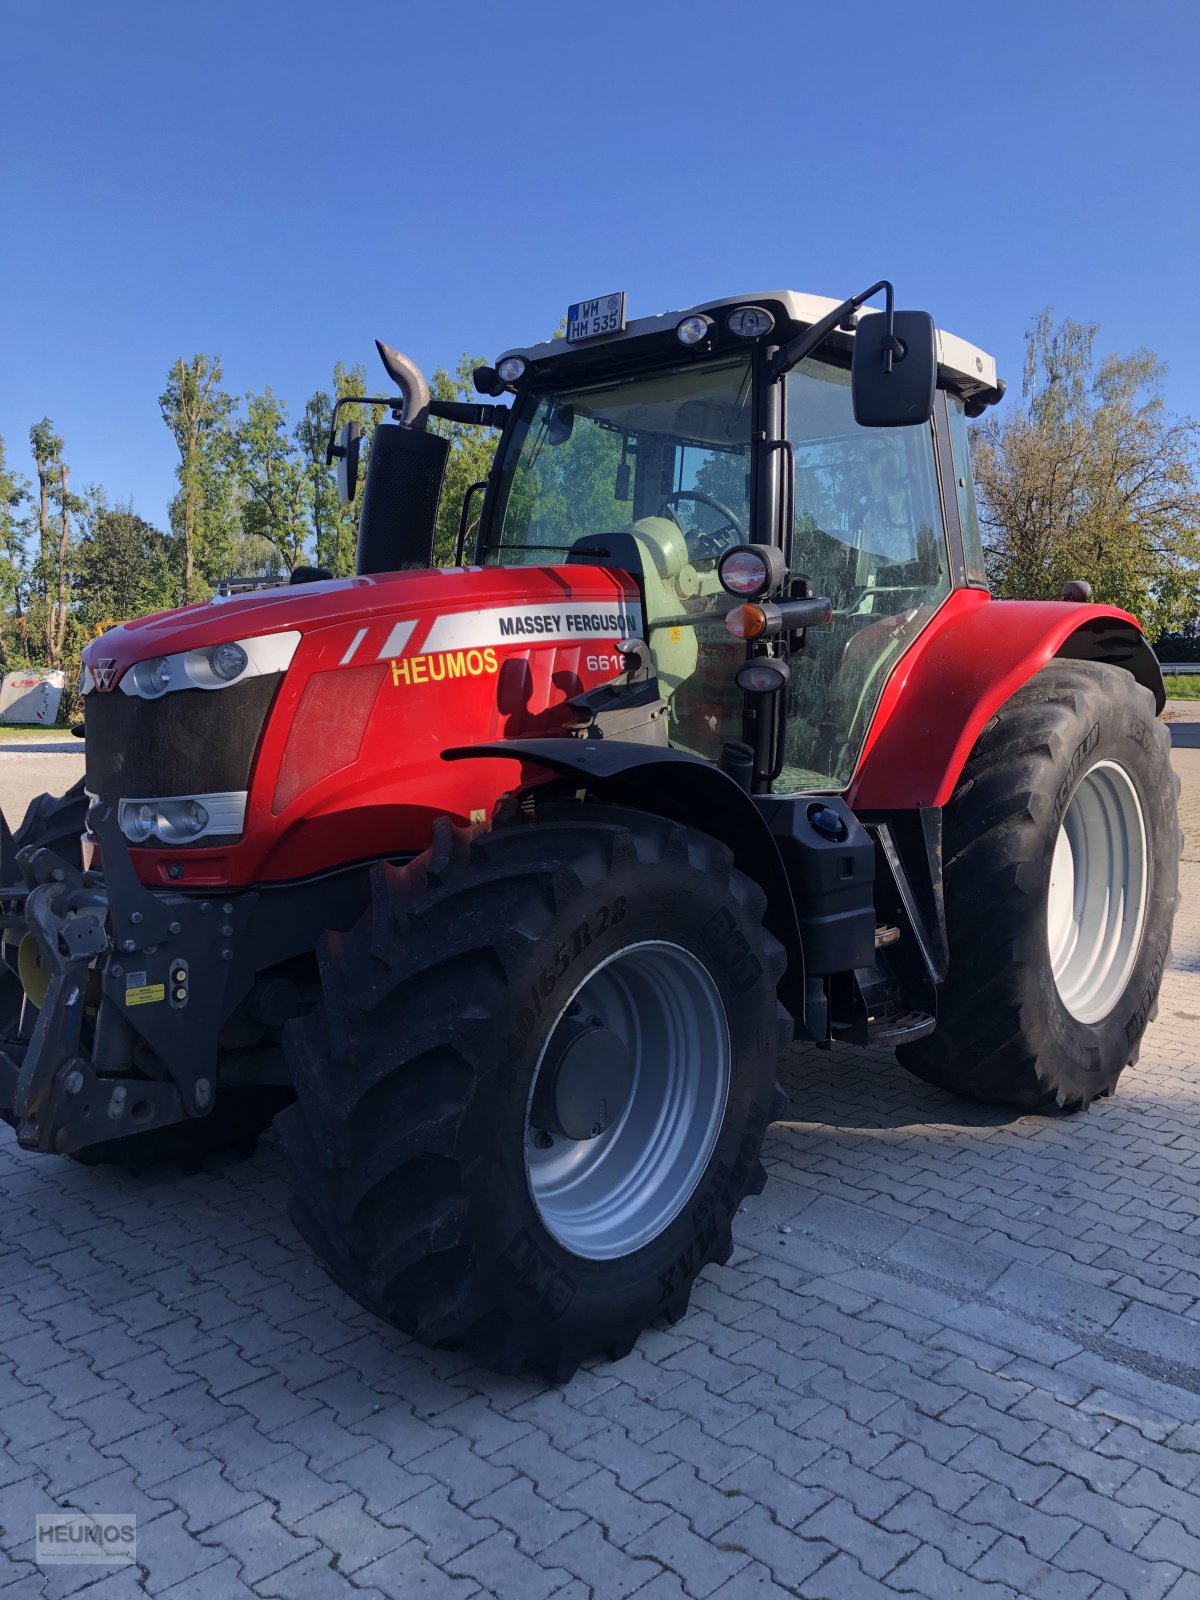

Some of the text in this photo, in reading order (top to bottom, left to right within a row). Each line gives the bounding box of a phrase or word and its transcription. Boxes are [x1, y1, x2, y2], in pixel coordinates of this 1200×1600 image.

[582, 301, 599, 319] WM
[571, 312, 618, 338] HM 535
[499, 614, 637, 636] MASSEY FERGUSON
[391, 648, 499, 687] HEUMOS
[495, 1228, 578, 1322] BKT
